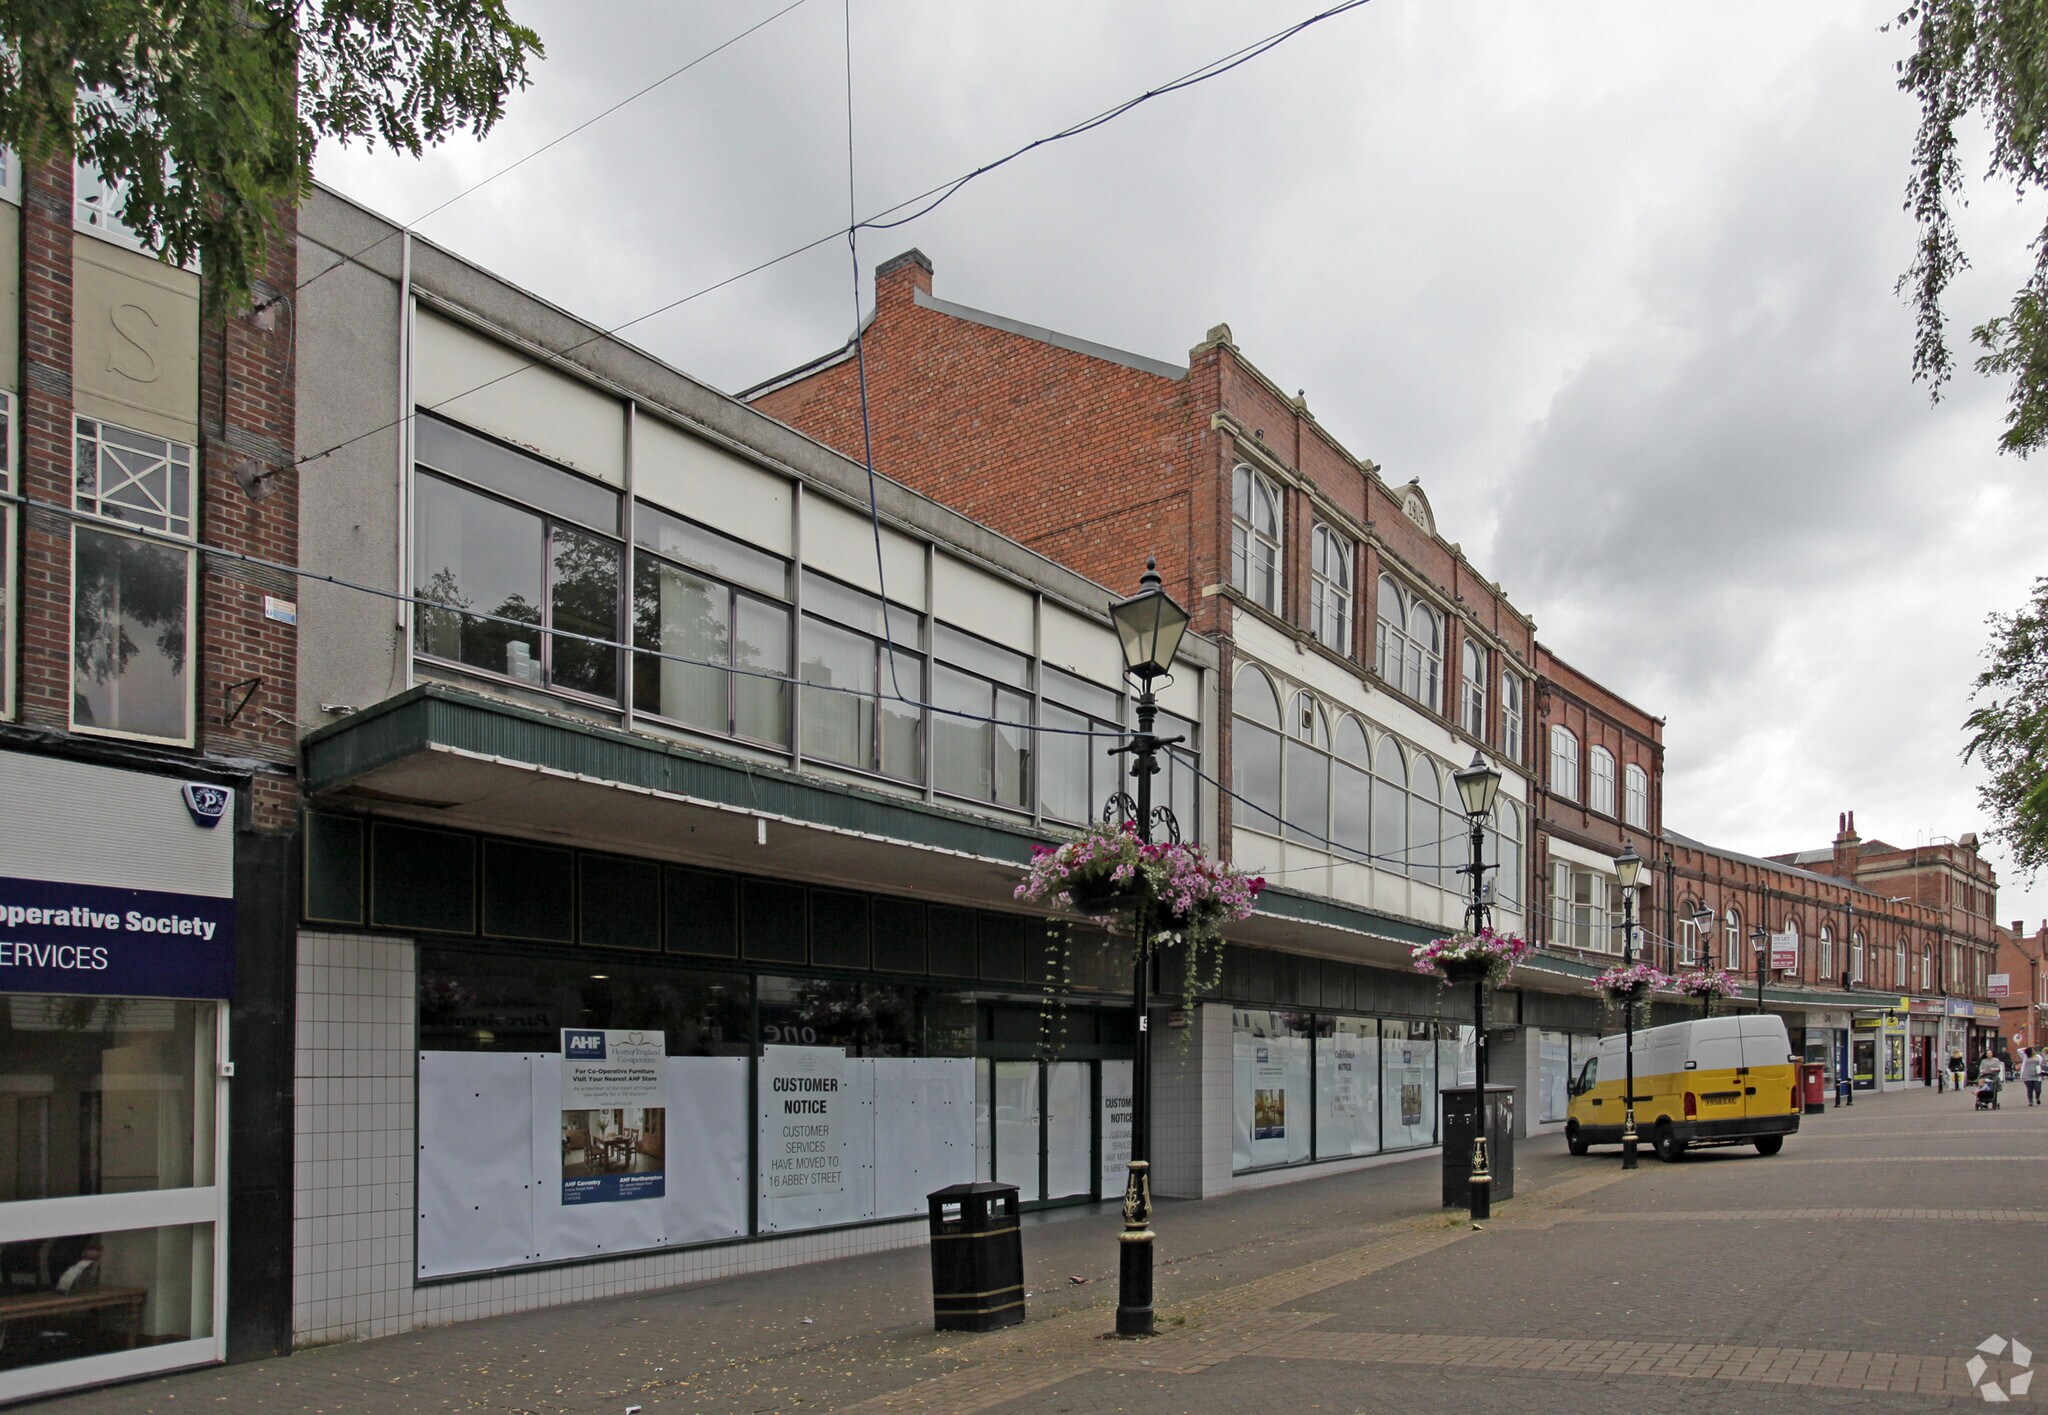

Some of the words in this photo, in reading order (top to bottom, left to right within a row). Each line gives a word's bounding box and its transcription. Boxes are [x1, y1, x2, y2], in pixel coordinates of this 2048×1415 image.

[106, 303, 162, 383] S
[125, 911, 216, 941] Society
[0, 942, 108, 970] ERVICES
[570, 1036, 600, 1049] AHF
[588, 1068, 627, 1076] Co-Operative
[774, 1078, 838, 1092] CUSTOMER
[785, 1100, 826, 1114] NOTICE
[783, 1125, 829, 1137] CUSTOMER
[786, 1141, 825, 1153] SERVICES
[772, 1158, 793, 1170] HAVE
[797, 1157, 825, 1169] MOVED
[828, 1156, 839, 1167] TO
[769, 1176, 779, 1187] 16
[782, 1174, 809, 1186] ABBEY
[811, 1172, 841, 1184] STREET
